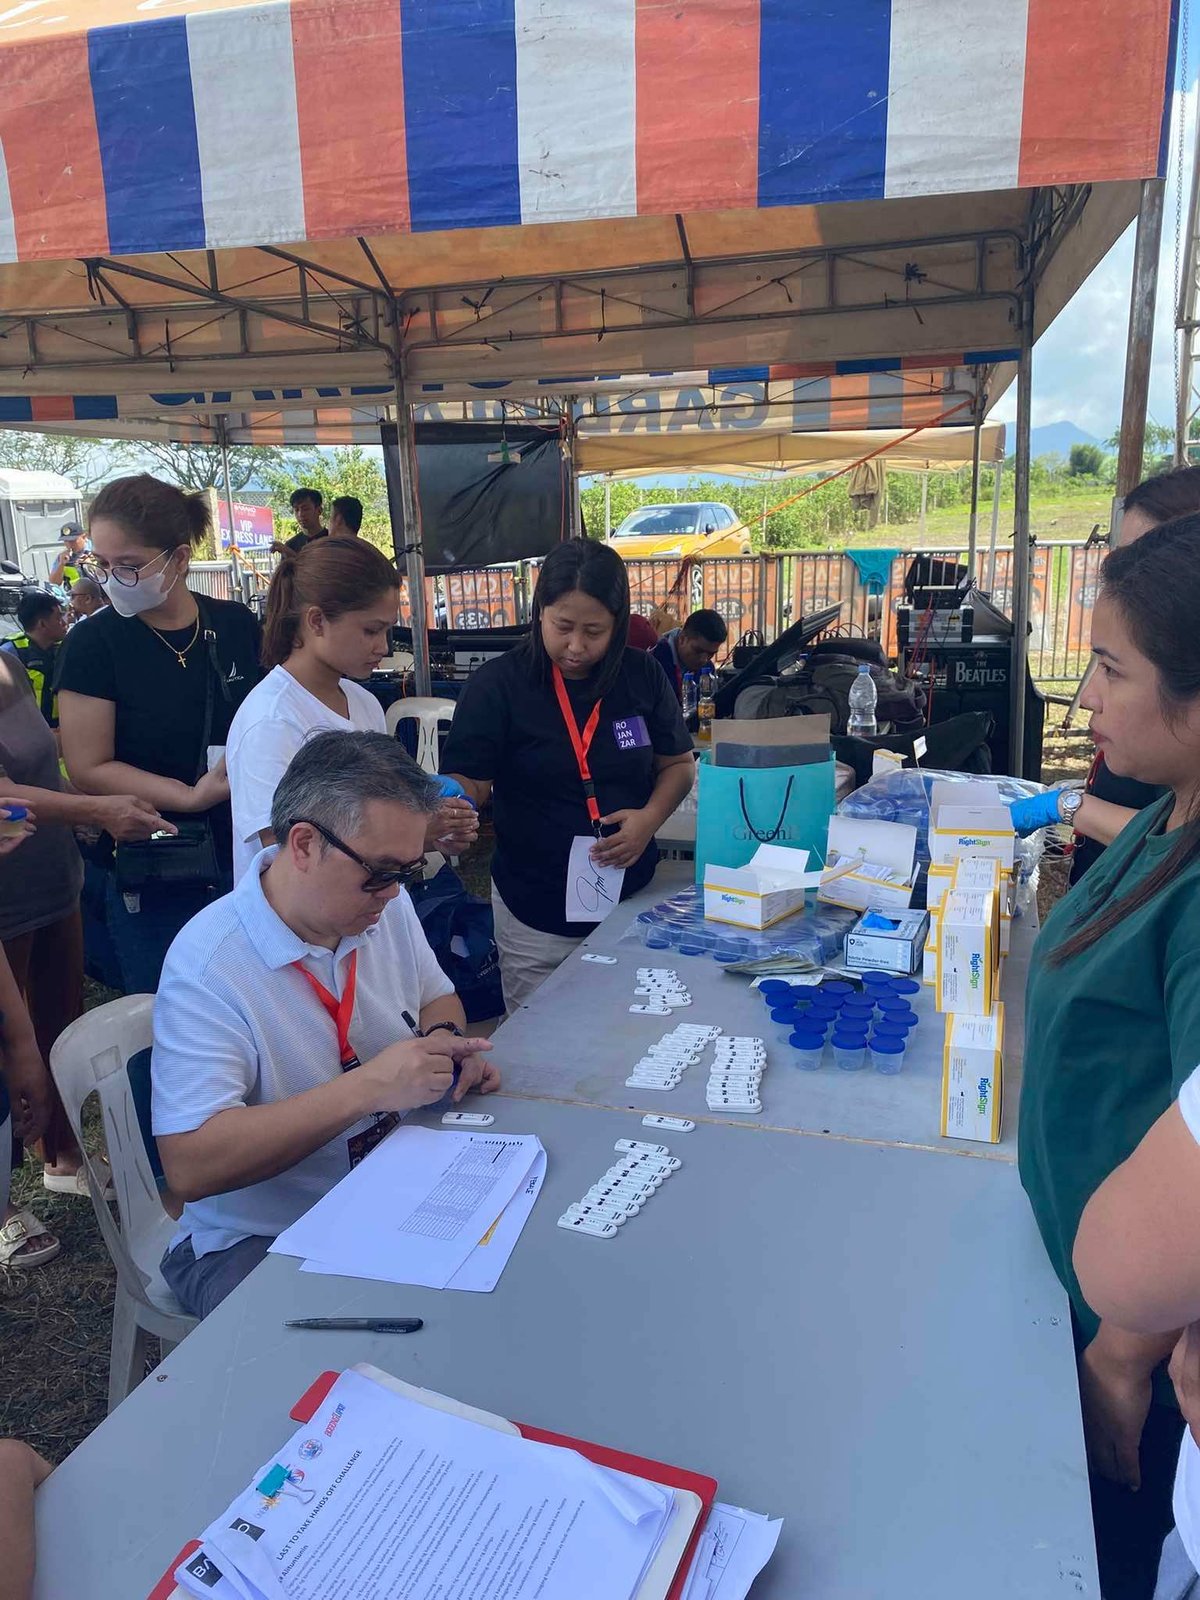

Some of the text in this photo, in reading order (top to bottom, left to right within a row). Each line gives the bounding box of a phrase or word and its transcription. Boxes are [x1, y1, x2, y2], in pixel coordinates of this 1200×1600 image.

[240, 519, 257, 532] VIP
[220, 528, 254, 545] EXRESS
[976, 660, 987, 668] THE
[955, 661, 1007, 686] BEATLES
[615, 721, 627, 730] RO
[617, 729, 633, 740] JAN
[619, 738, 636, 748] ZAR
[958, 836, 991, 847] RightSign
[721, 893, 746, 905] RightSign
[970, 953, 983, 990] RightSign
[978, 1077, 991, 1115] RightSign
[276, 1545, 291, 1561] LAST
[289, 1534, 300, 1546] TO
[296, 1518, 313, 1537] TAKE
[309, 1495, 329, 1519] HANDS
[326, 1482, 338, 1497] OFF
[334, 1449, 363, 1485] CHALLENGE
